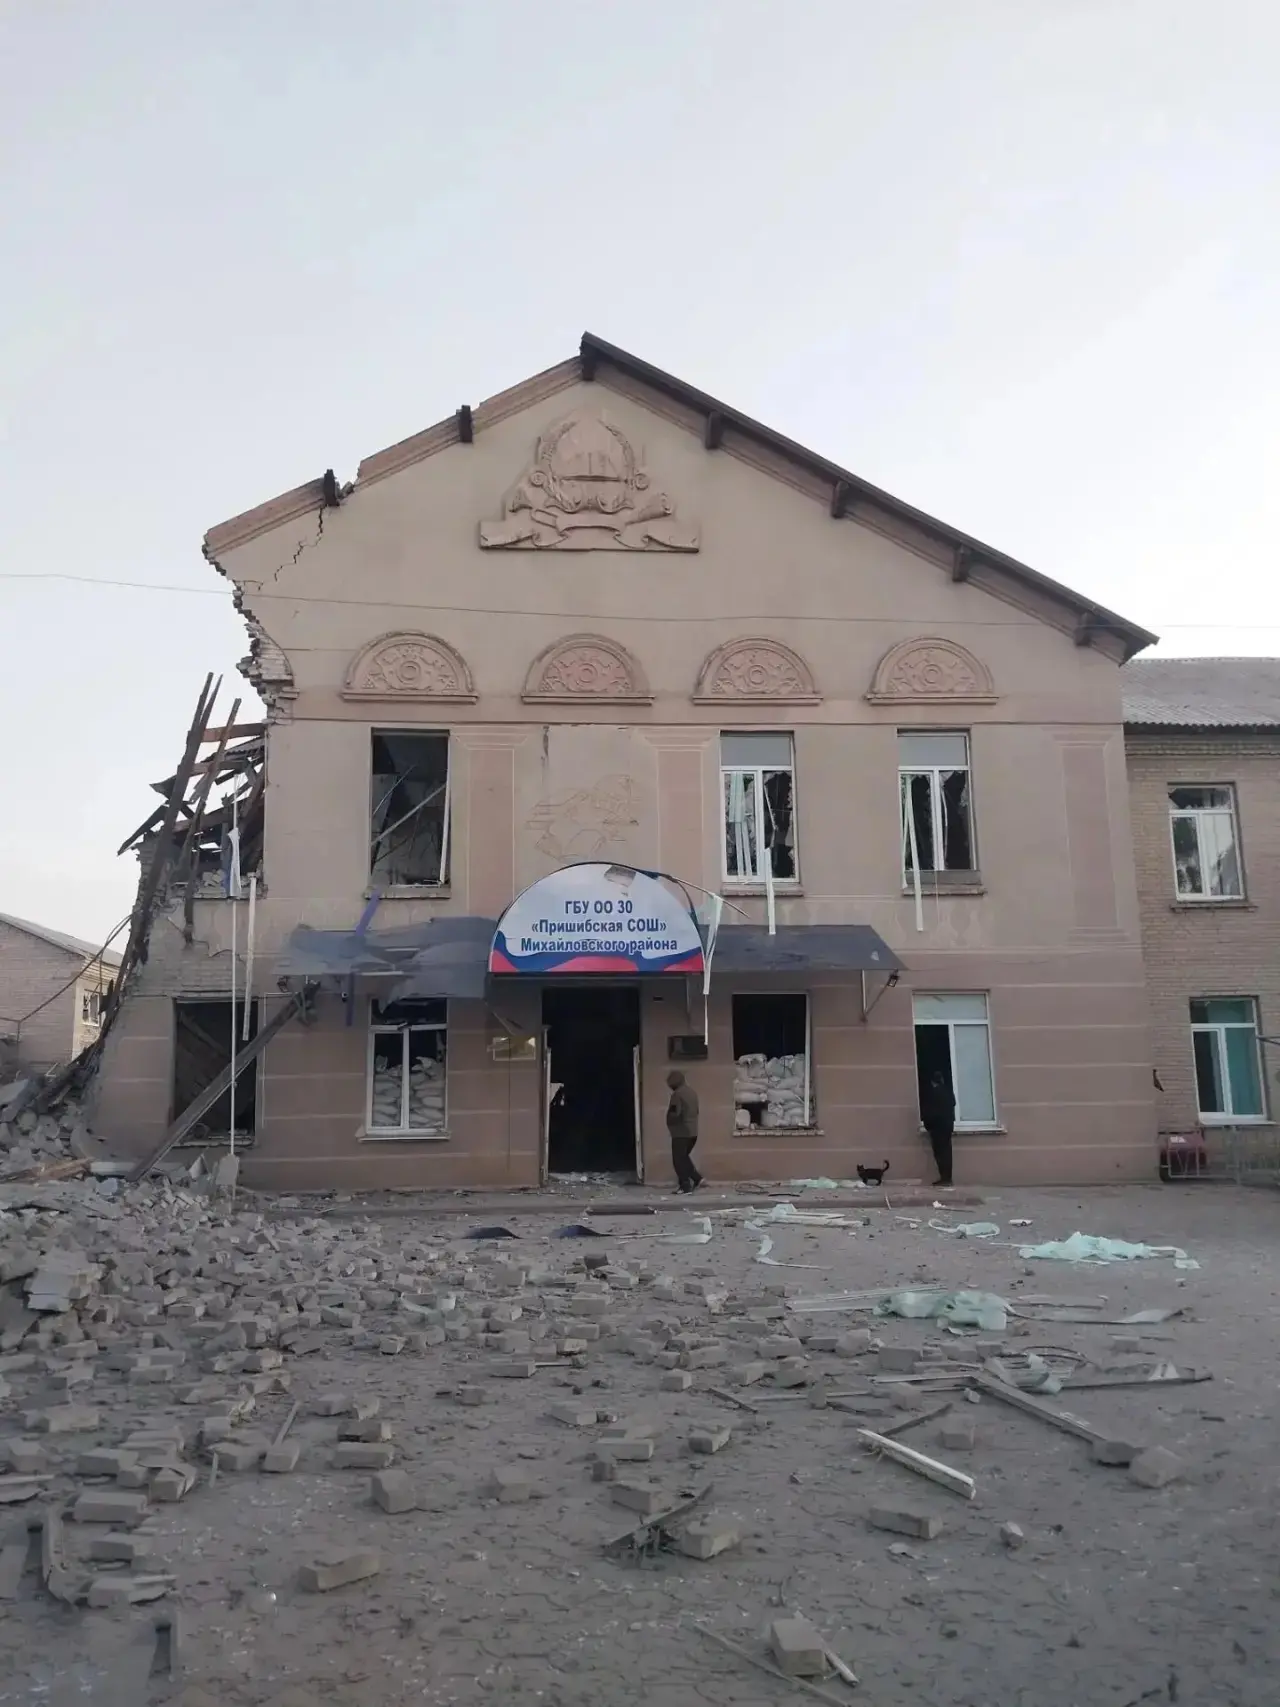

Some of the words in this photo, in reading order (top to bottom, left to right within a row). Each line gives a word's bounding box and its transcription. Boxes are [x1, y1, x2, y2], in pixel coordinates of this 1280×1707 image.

[565, 900, 589, 914] ГБУ
[618, 900, 633, 914] 30
[531, 918, 623, 935] «Пришибская
[627, 918, 667, 933] СОШ»
[521, 938, 626, 953] Михайловского
[629, 937, 677, 954] района
